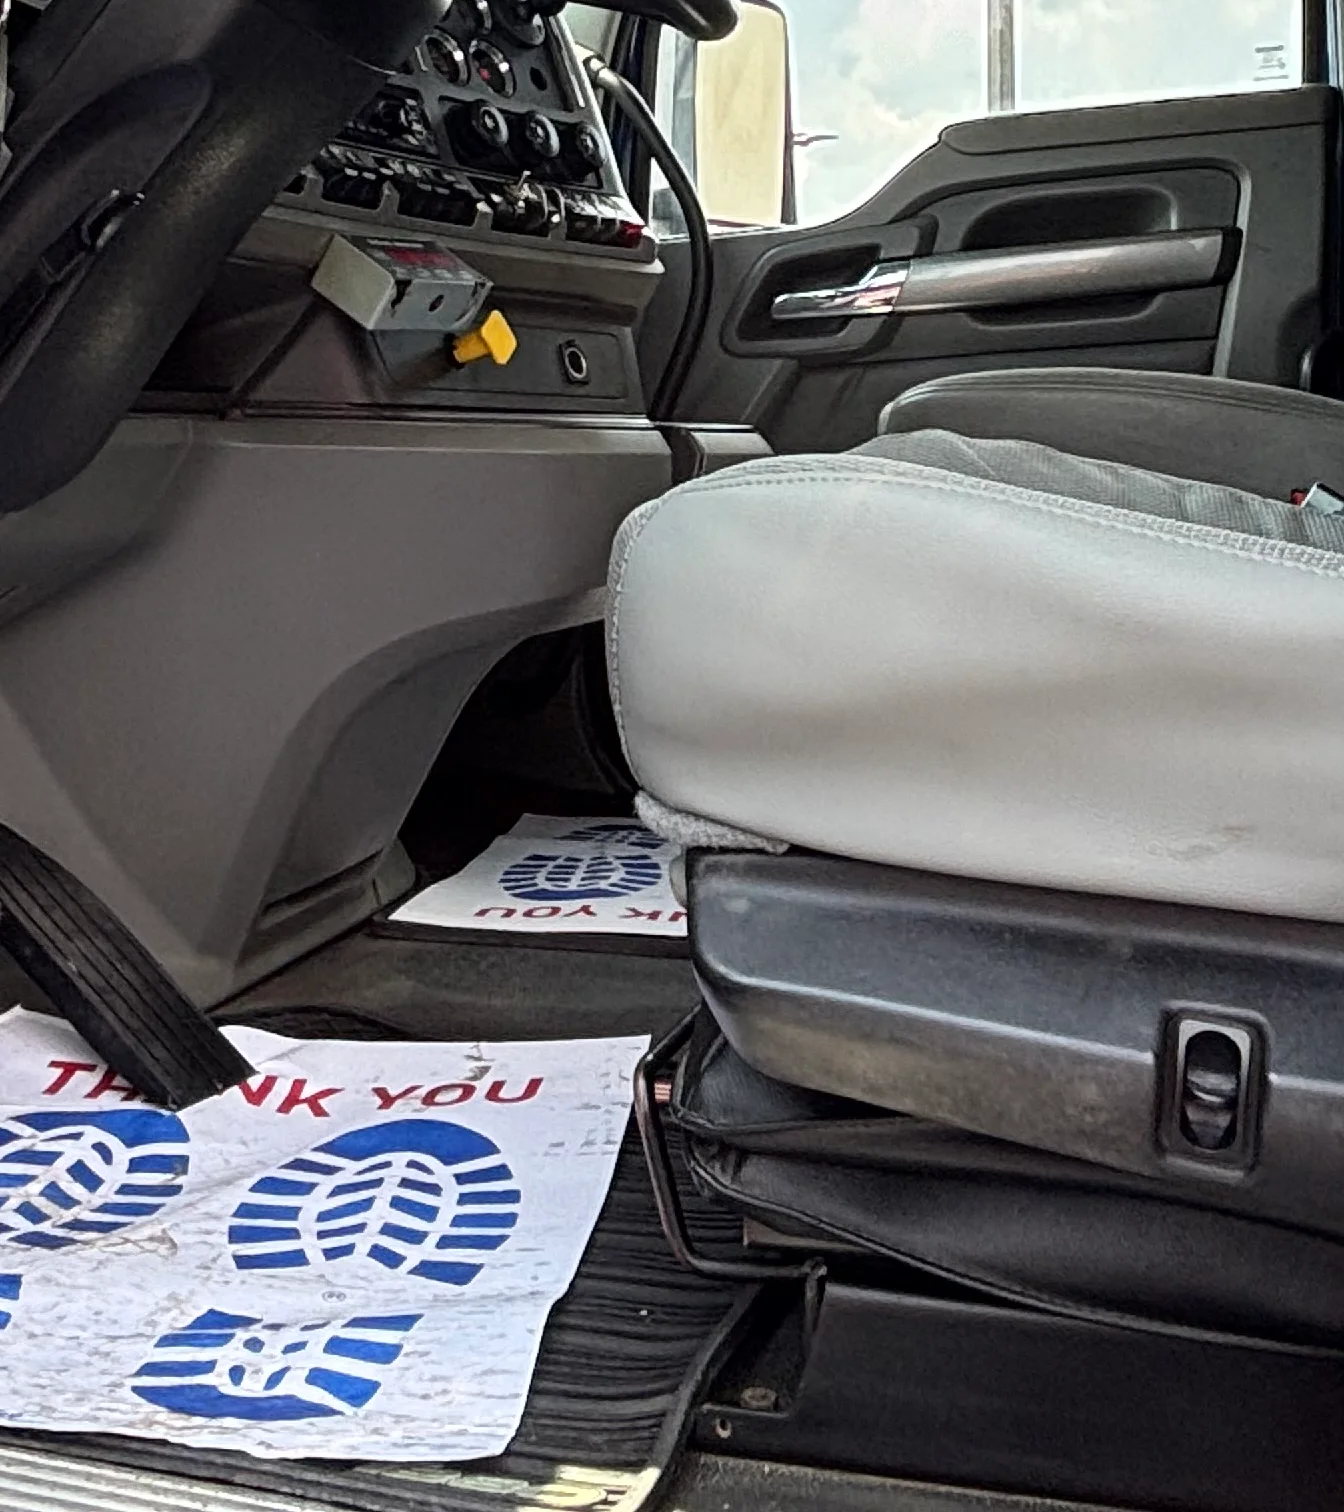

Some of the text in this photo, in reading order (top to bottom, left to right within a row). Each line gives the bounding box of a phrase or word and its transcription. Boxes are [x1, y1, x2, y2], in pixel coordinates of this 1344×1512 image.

[473, 904, 598, 918] YOU
[42, 1060, 544, 1118] THNK YOU
